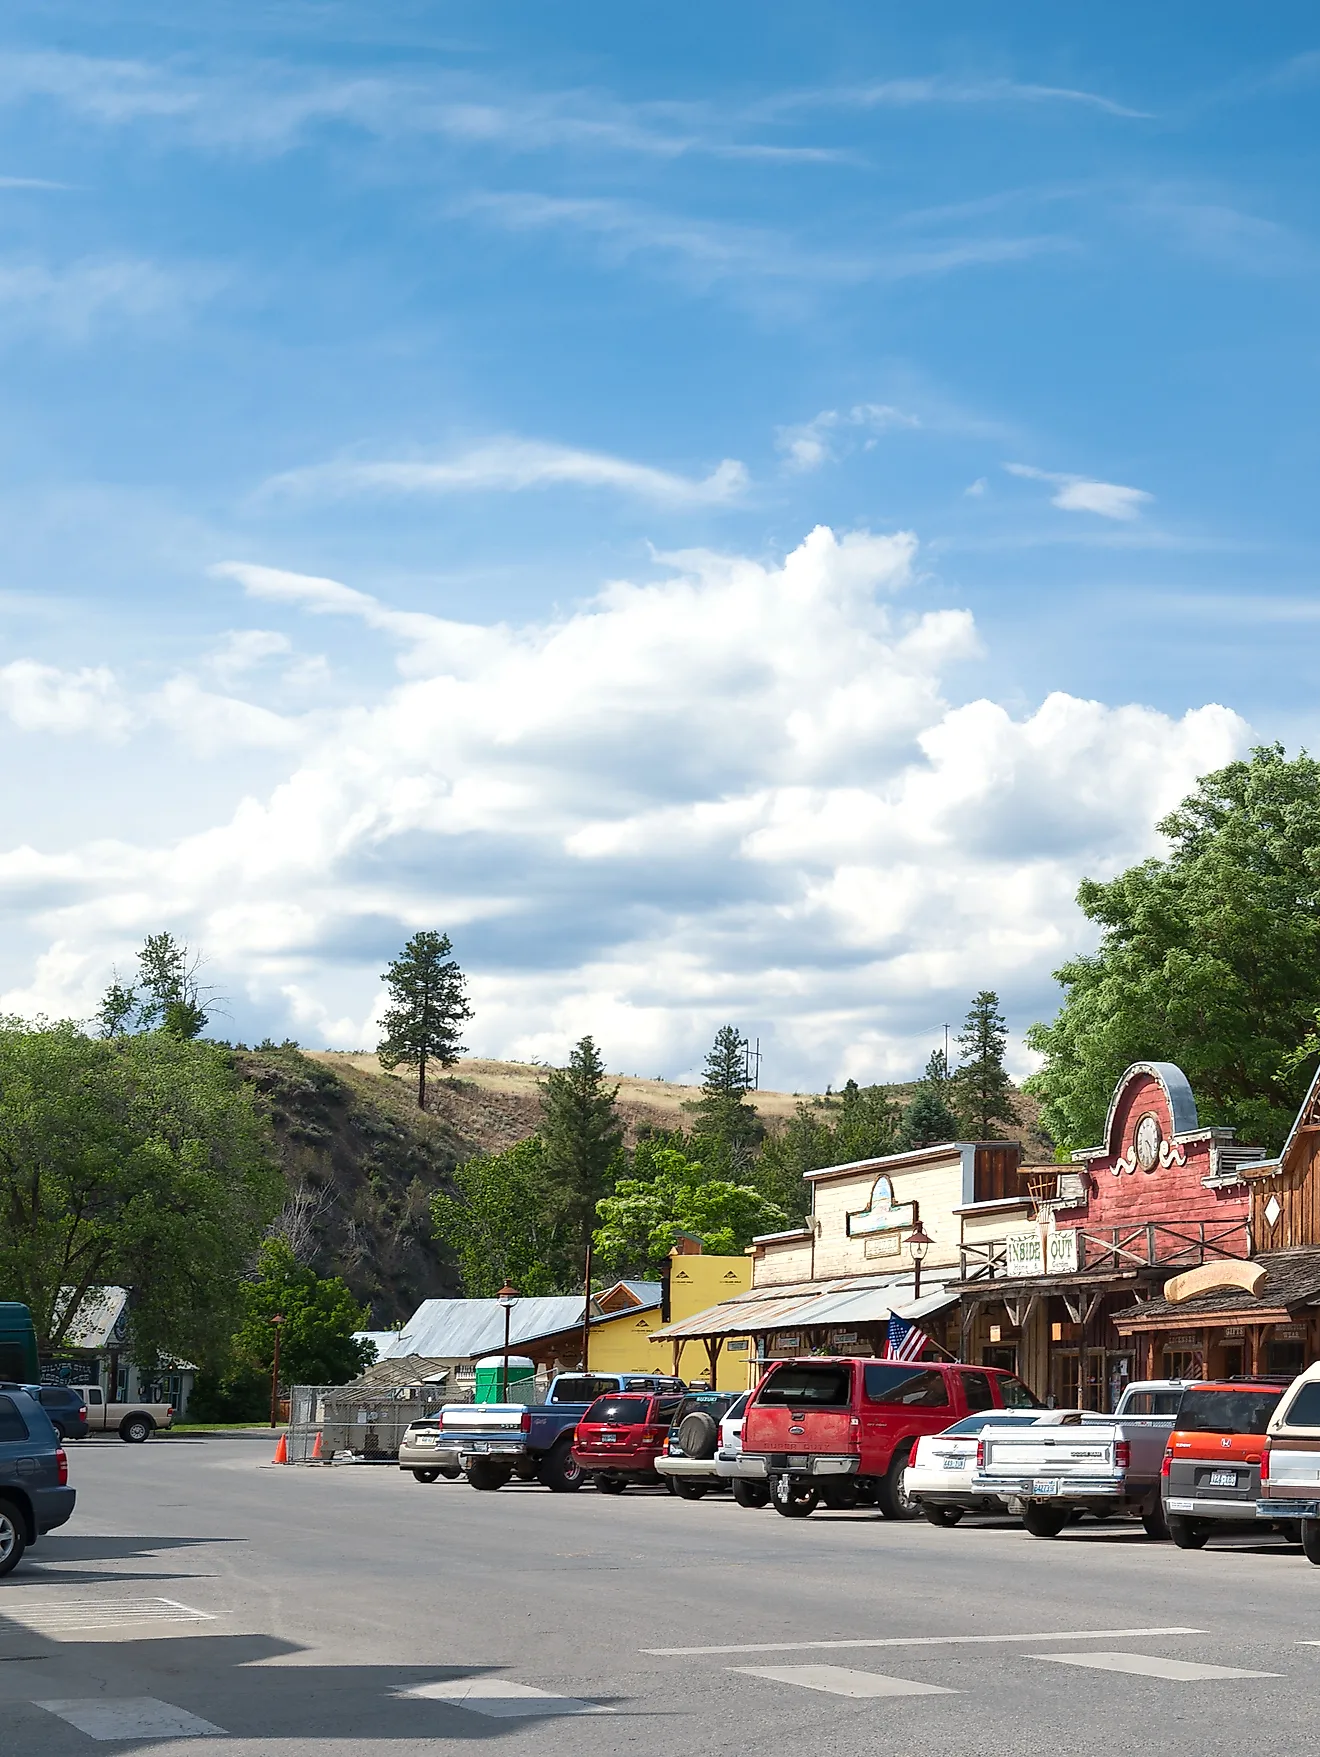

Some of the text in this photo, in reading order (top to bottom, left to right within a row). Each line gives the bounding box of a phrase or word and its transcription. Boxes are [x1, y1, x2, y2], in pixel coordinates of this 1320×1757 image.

[1008, 1239, 1073, 1262] INSIDE OUT
[1225, 1327, 1244, 1336] GIFTS
